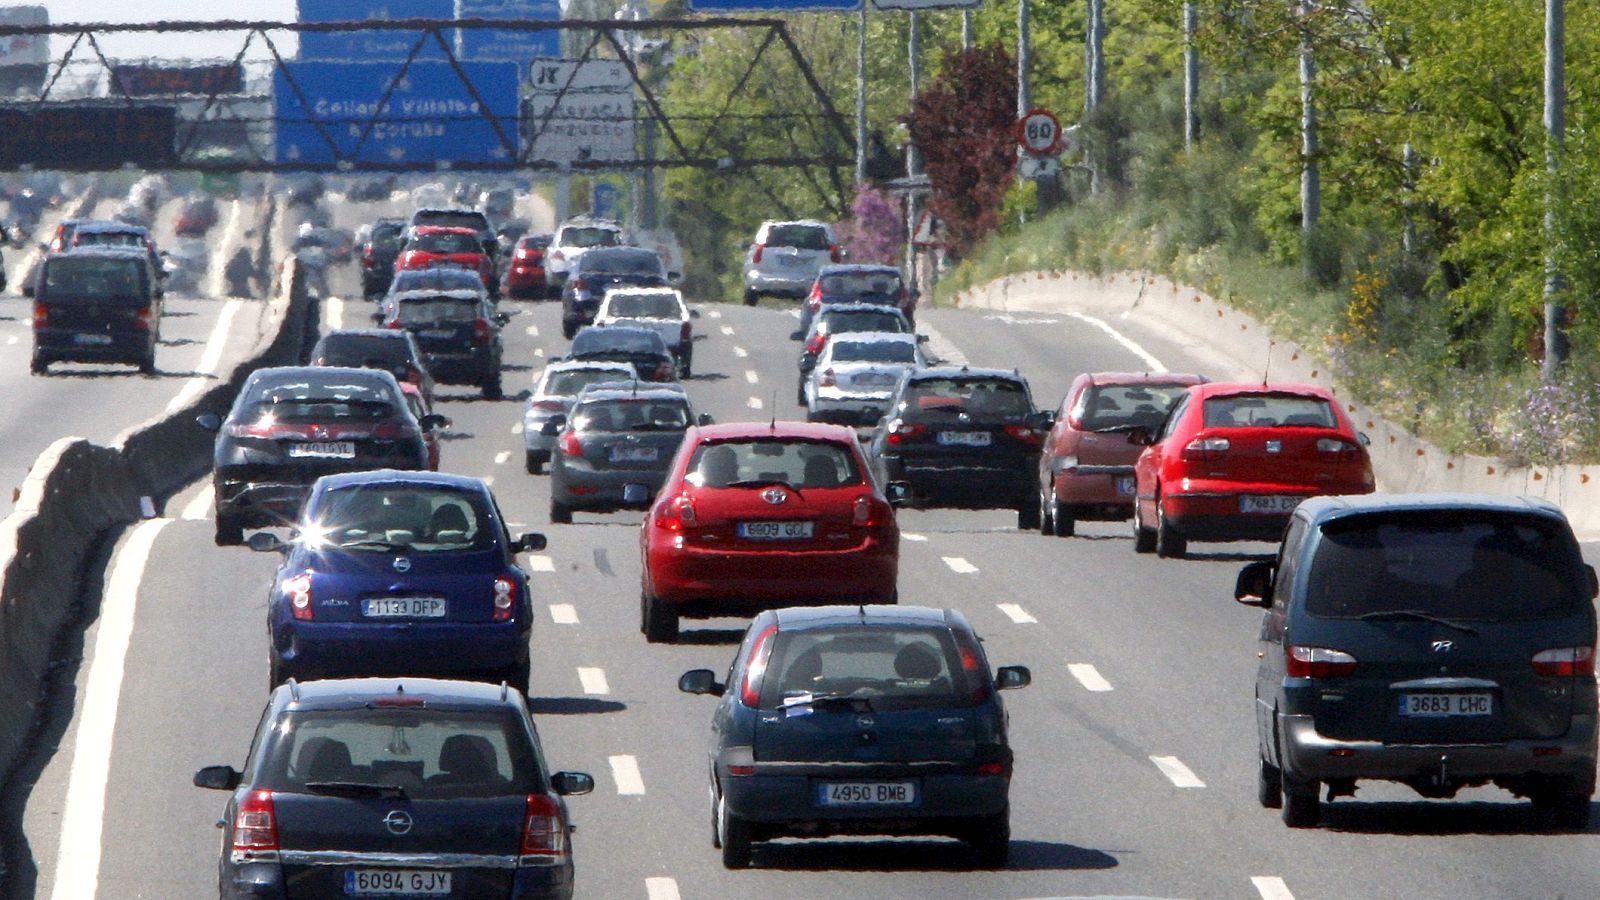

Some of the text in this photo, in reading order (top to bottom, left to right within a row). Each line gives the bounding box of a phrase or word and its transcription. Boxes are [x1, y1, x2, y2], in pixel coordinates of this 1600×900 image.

[376, 600, 438, 614] 1133 DFP
[1412, 696, 1450, 712] 3683
[832, 785, 906, 801] 4950 BMB
[358, 872, 446, 890] 6094 GJY
